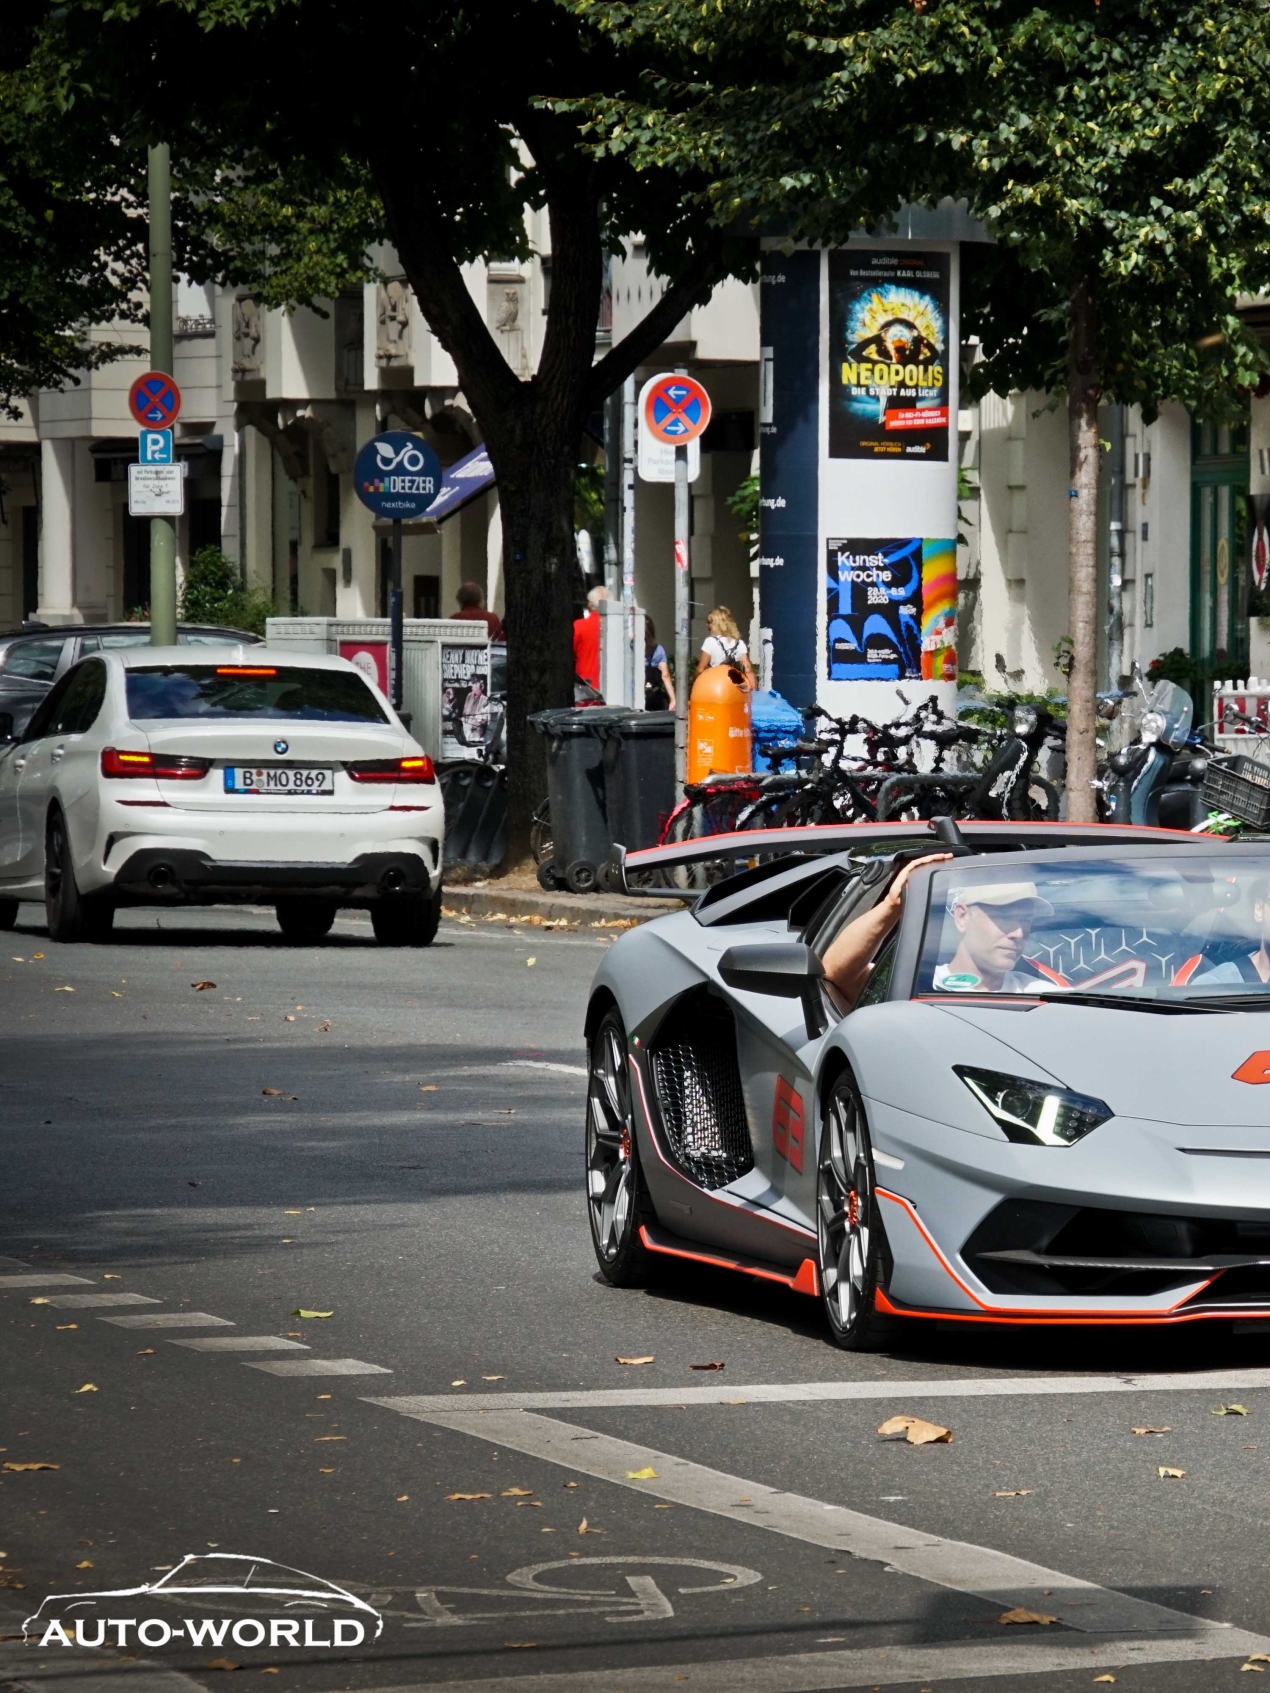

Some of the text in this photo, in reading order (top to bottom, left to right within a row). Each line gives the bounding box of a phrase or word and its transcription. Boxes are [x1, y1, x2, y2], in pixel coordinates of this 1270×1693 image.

[896, 269, 915, 278] KARL
[916, 271, 940, 279] OLSBERG
[841, 362, 943, 387] NEOPOLIS
[851, 386, 938, 398] DIE STADT AUS LICHT
[147, 434, 164, 460] P
[906, 445, 926, 454] audible
[390, 476, 434, 494] DEEZER
[381, 501, 416, 509] nextbike
[837, 551, 889, 567] Kunst-
[838, 567, 892, 582] woche
[867, 595, 889, 605] 2020
[442, 649, 488, 665] KENNY WAYNE
[355, 661, 372, 675] THE
[242, 770, 255, 787] B
[266, 771, 290, 788] MO
[292, 770, 326, 788] 869
